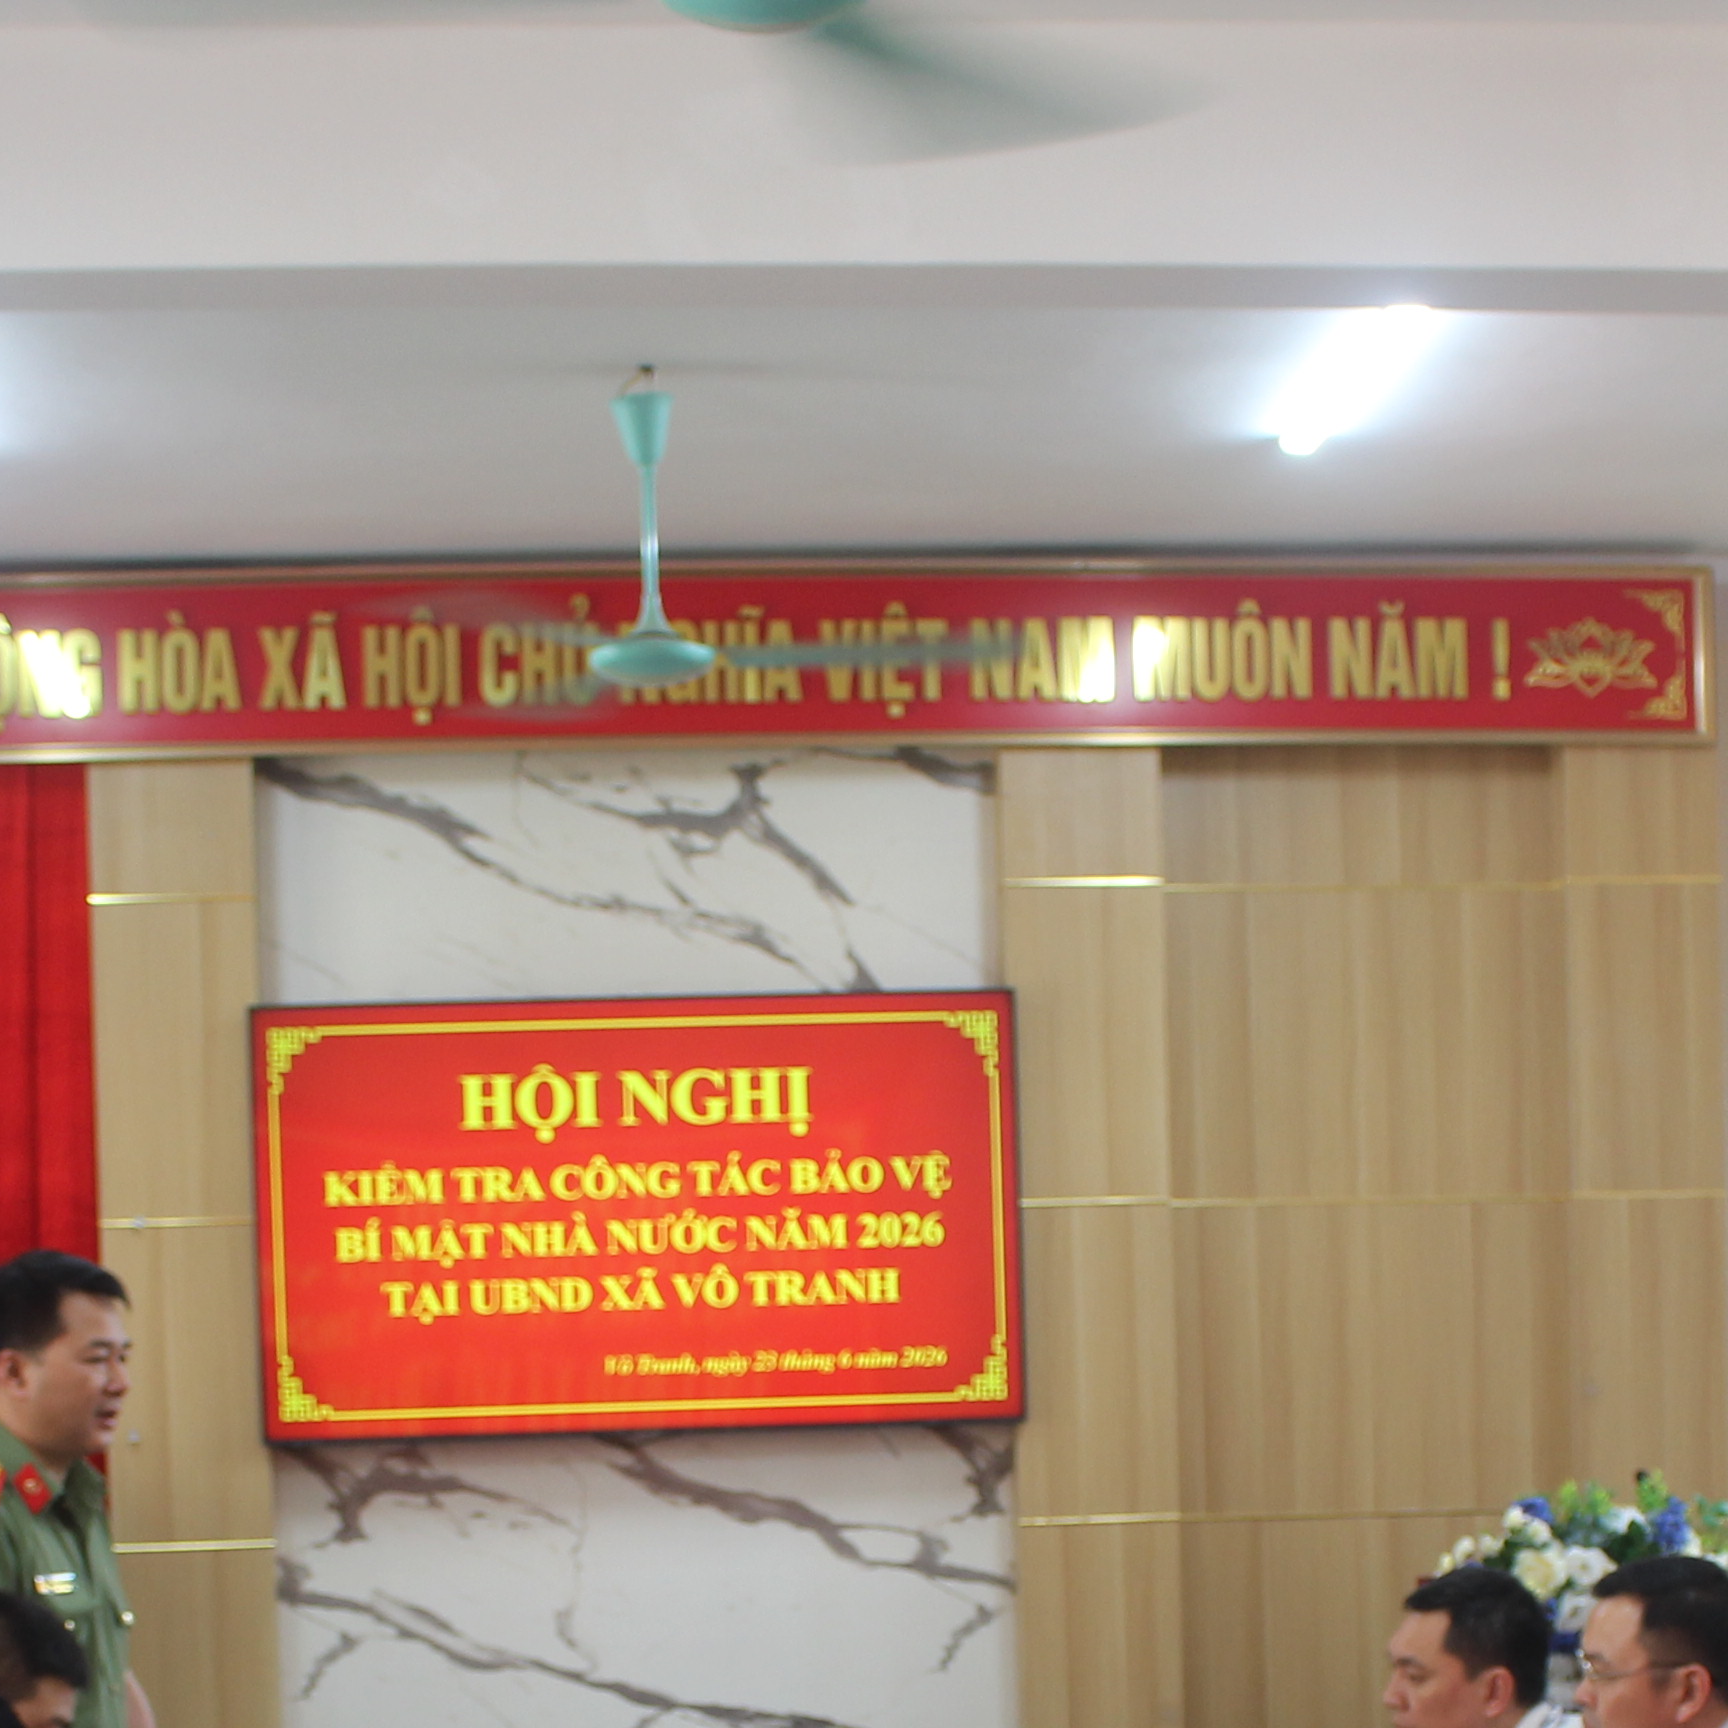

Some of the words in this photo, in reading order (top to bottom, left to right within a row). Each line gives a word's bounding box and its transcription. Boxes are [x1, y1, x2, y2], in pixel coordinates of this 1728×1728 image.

[117, 608, 240, 716] HÒA
[257, 612, 347, 712] XÃ
[360, 605, 462, 725] HỘI
[969, 614, 1116, 703] NAM
[1131, 597, 1313, 702] MUÔN
[1328, 603, 1468, 701] NĂM
[459, 1063, 601, 1143] HỘI
[617, 1065, 813, 1138] NGHỊ
[323, 1158, 446, 1208] KIỂM
[449, 1165, 547, 1204] TRA
[548, 1153, 682, 1201] CÔNG
[686, 1149, 782, 1197] TÁC
[788, 1146, 885, 1195] BẢO
[888, 1148, 954, 1200] VỆ
[334, 1215, 382, 1264] BÍ
[390, 1217, 495, 1269] MẬT
[499, 1209, 600, 1258] NHÀ
[604, 1206, 738, 1257] NƯỚC
[744, 1205, 849, 1252] NĂM
[855, 1209, 947, 1250] 2026
[379, 1278, 461, 1326] TẠI
[468, 1275, 594, 1316] UBND
[598, 1265, 667, 1312] XÃ
[742, 1266, 902, 1308] TRANH
[899, 1345, 948, 1368] 2026
